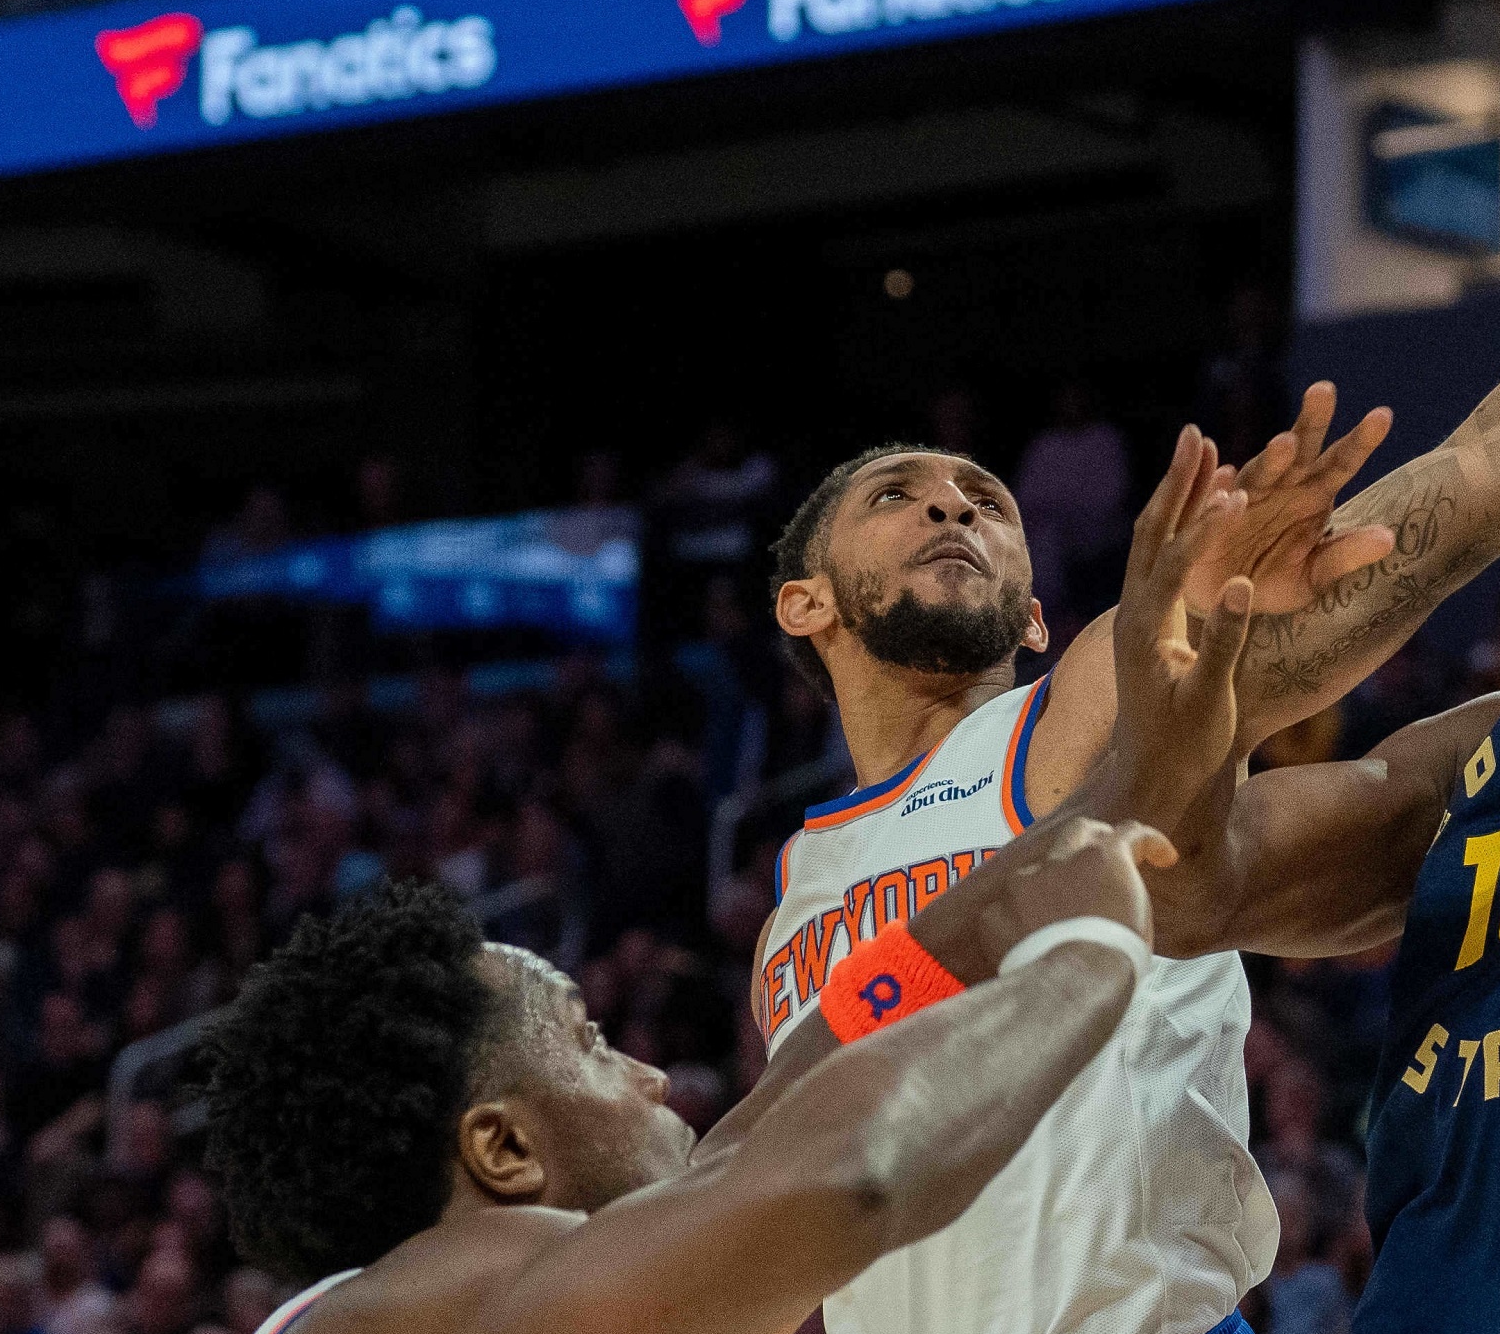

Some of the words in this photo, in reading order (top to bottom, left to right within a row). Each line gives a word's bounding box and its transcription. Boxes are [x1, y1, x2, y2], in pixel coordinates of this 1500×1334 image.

[202, 8, 494, 124] Fanatics
[901, 793, 935, 817] abu
[938, 770, 995, 802] dhabi
[906, 778, 955, 802] experience
